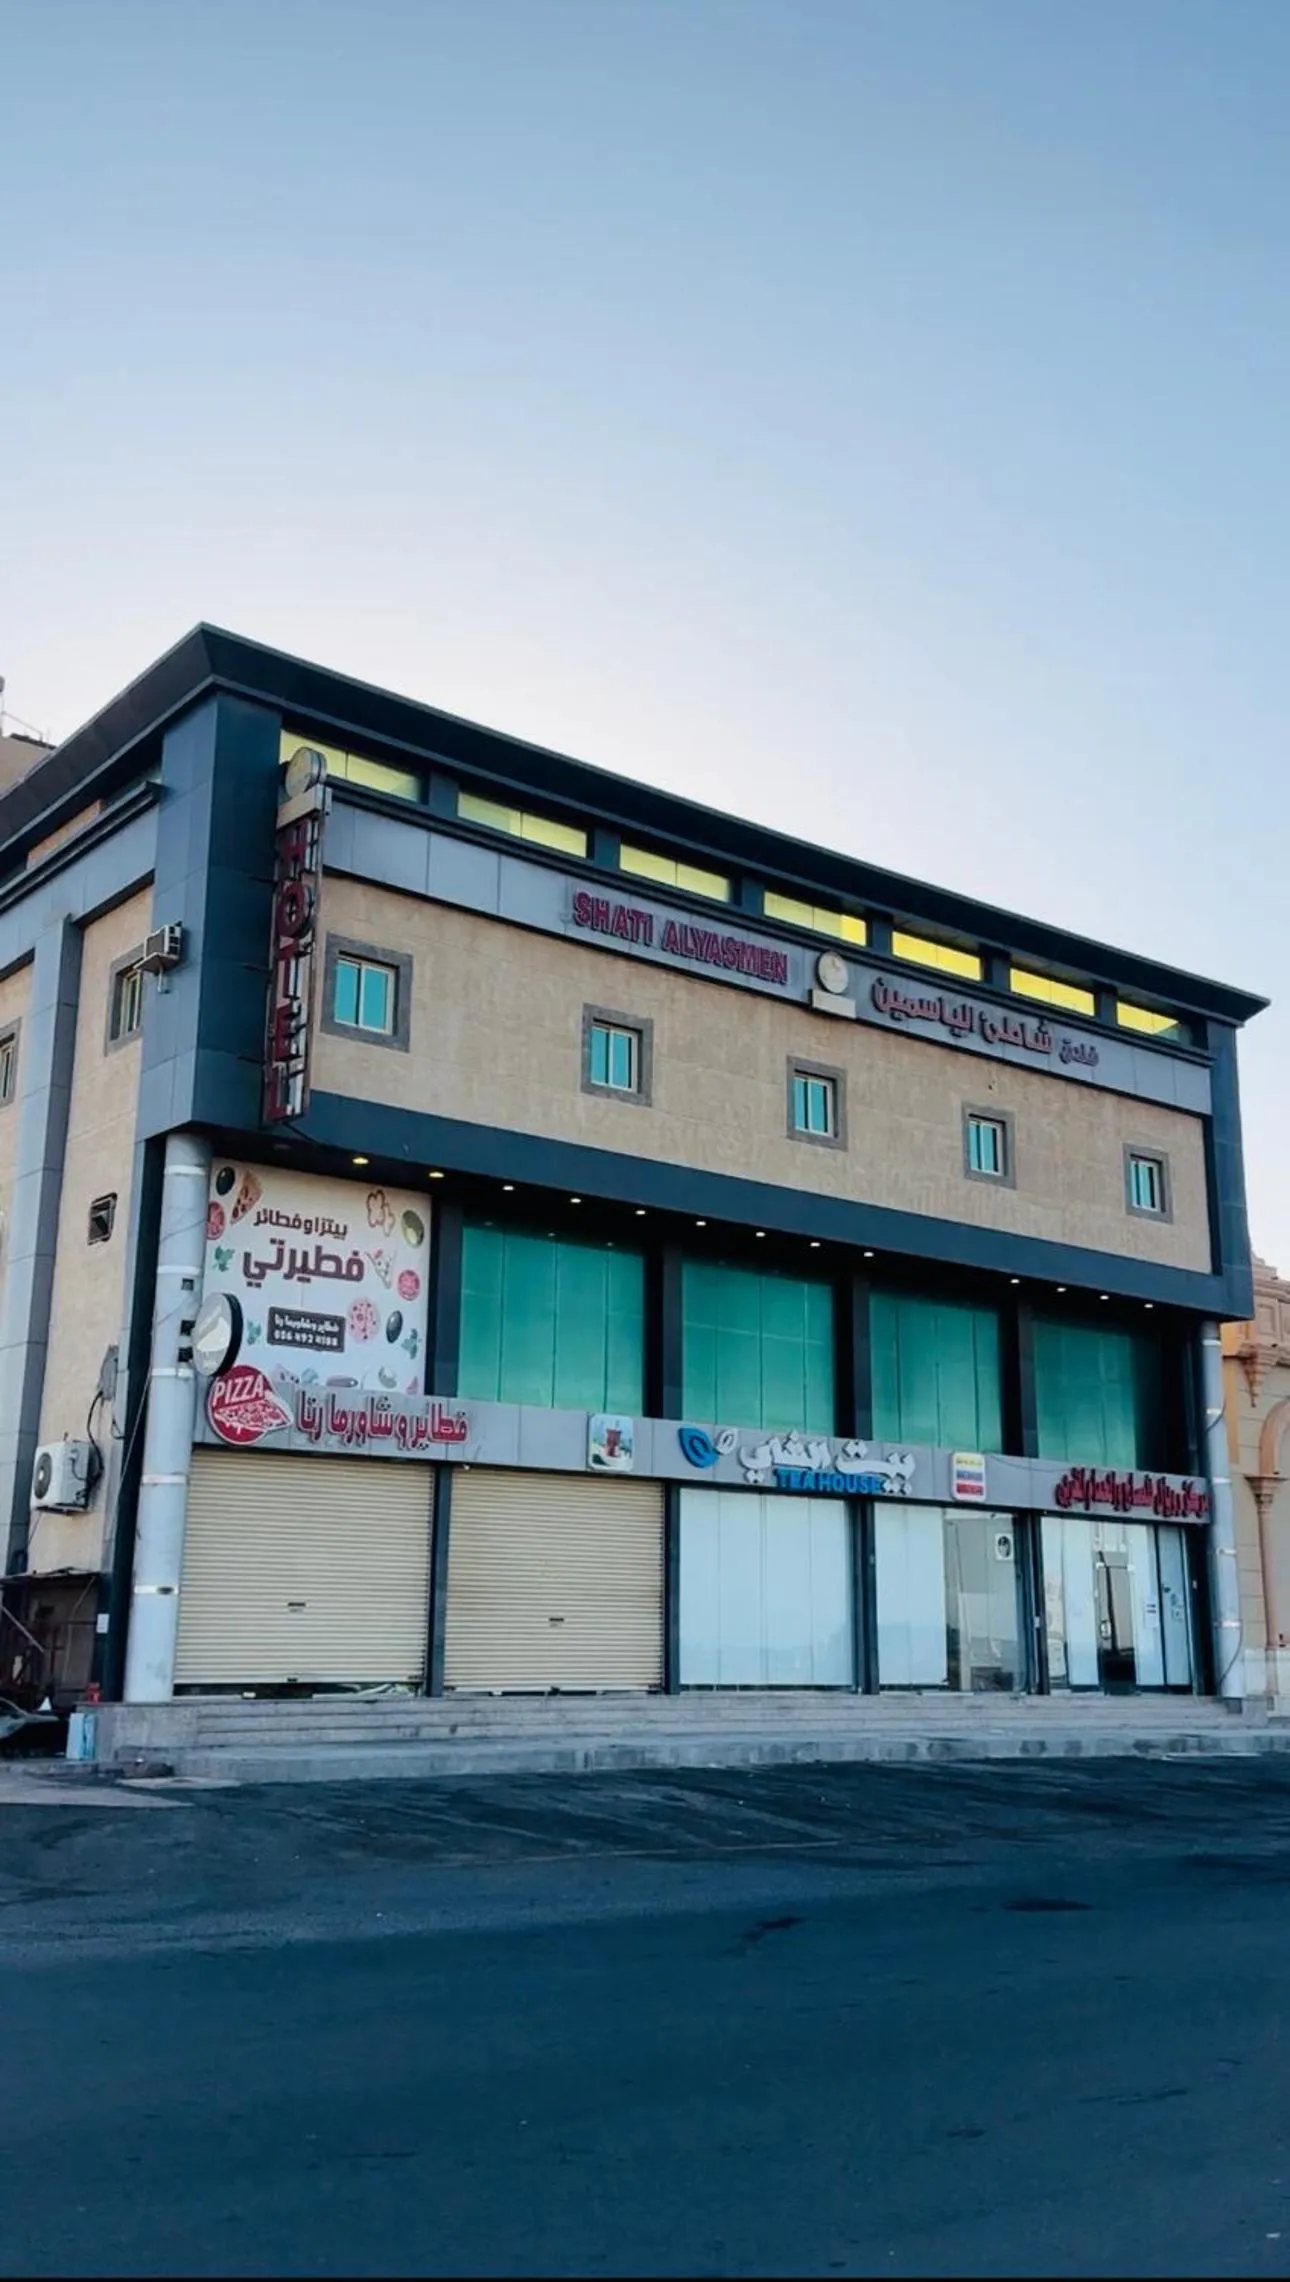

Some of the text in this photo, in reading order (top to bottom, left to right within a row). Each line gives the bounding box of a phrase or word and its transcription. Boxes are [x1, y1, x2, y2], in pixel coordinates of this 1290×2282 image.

[574, 892, 789, 984] SHATI ALYASMEN
[266, 818, 312, 1122] HOTEL
[871, 977, 1099, 1067] فندق شاطئ الياسمين
[315, 1217, 348, 1240] بيتزا
[242, 1237, 364, 1287] فطيرتي
[212, 1373, 264, 1408] PIZZA
[411, 1402, 469, 1450] فطاير
[737, 1429, 916, 1496] بيت الشاي
